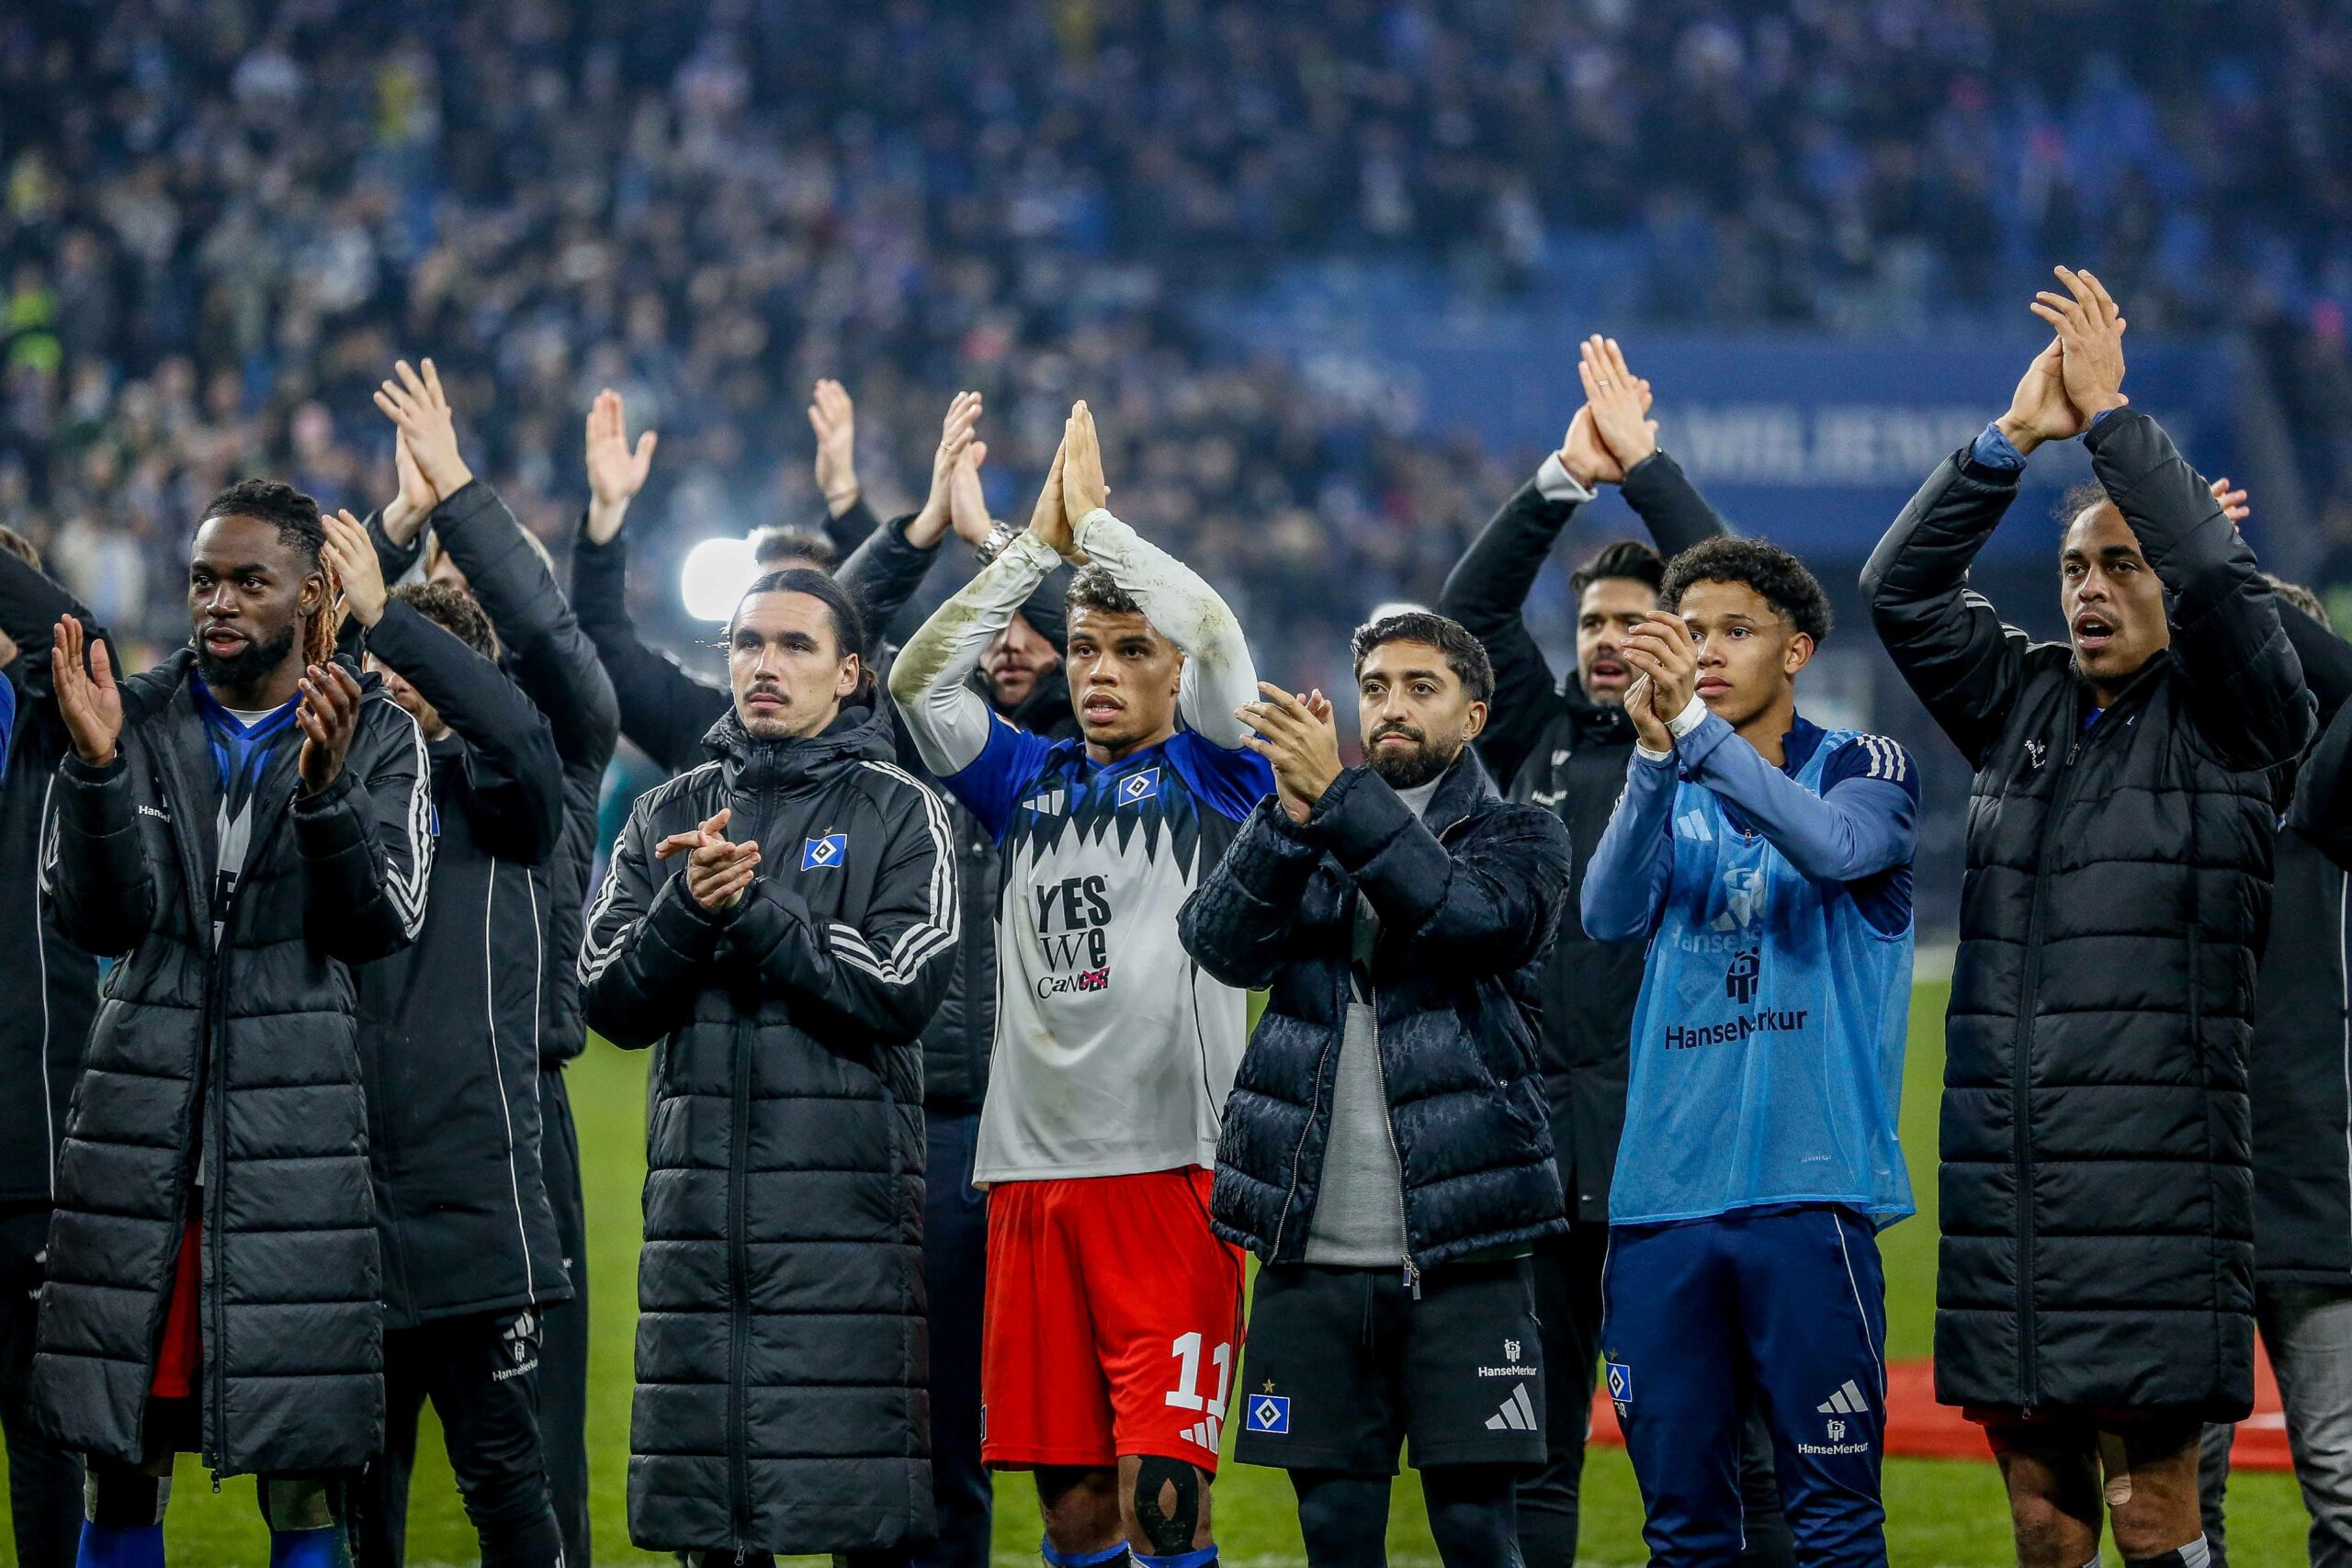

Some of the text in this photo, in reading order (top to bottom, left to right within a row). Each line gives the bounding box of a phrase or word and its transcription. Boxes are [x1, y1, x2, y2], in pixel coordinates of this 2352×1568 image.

[1036, 874, 1112, 933] YES
[1040, 928, 1107, 973] We
[1665, 1007, 1808, 1050] HanseMrkur
[1165, 1332, 1230, 1422] 11
[1478, 1365, 1537, 1377] HanseMerkur
[1798, 1442, 1869, 1455] HanseMerkur
